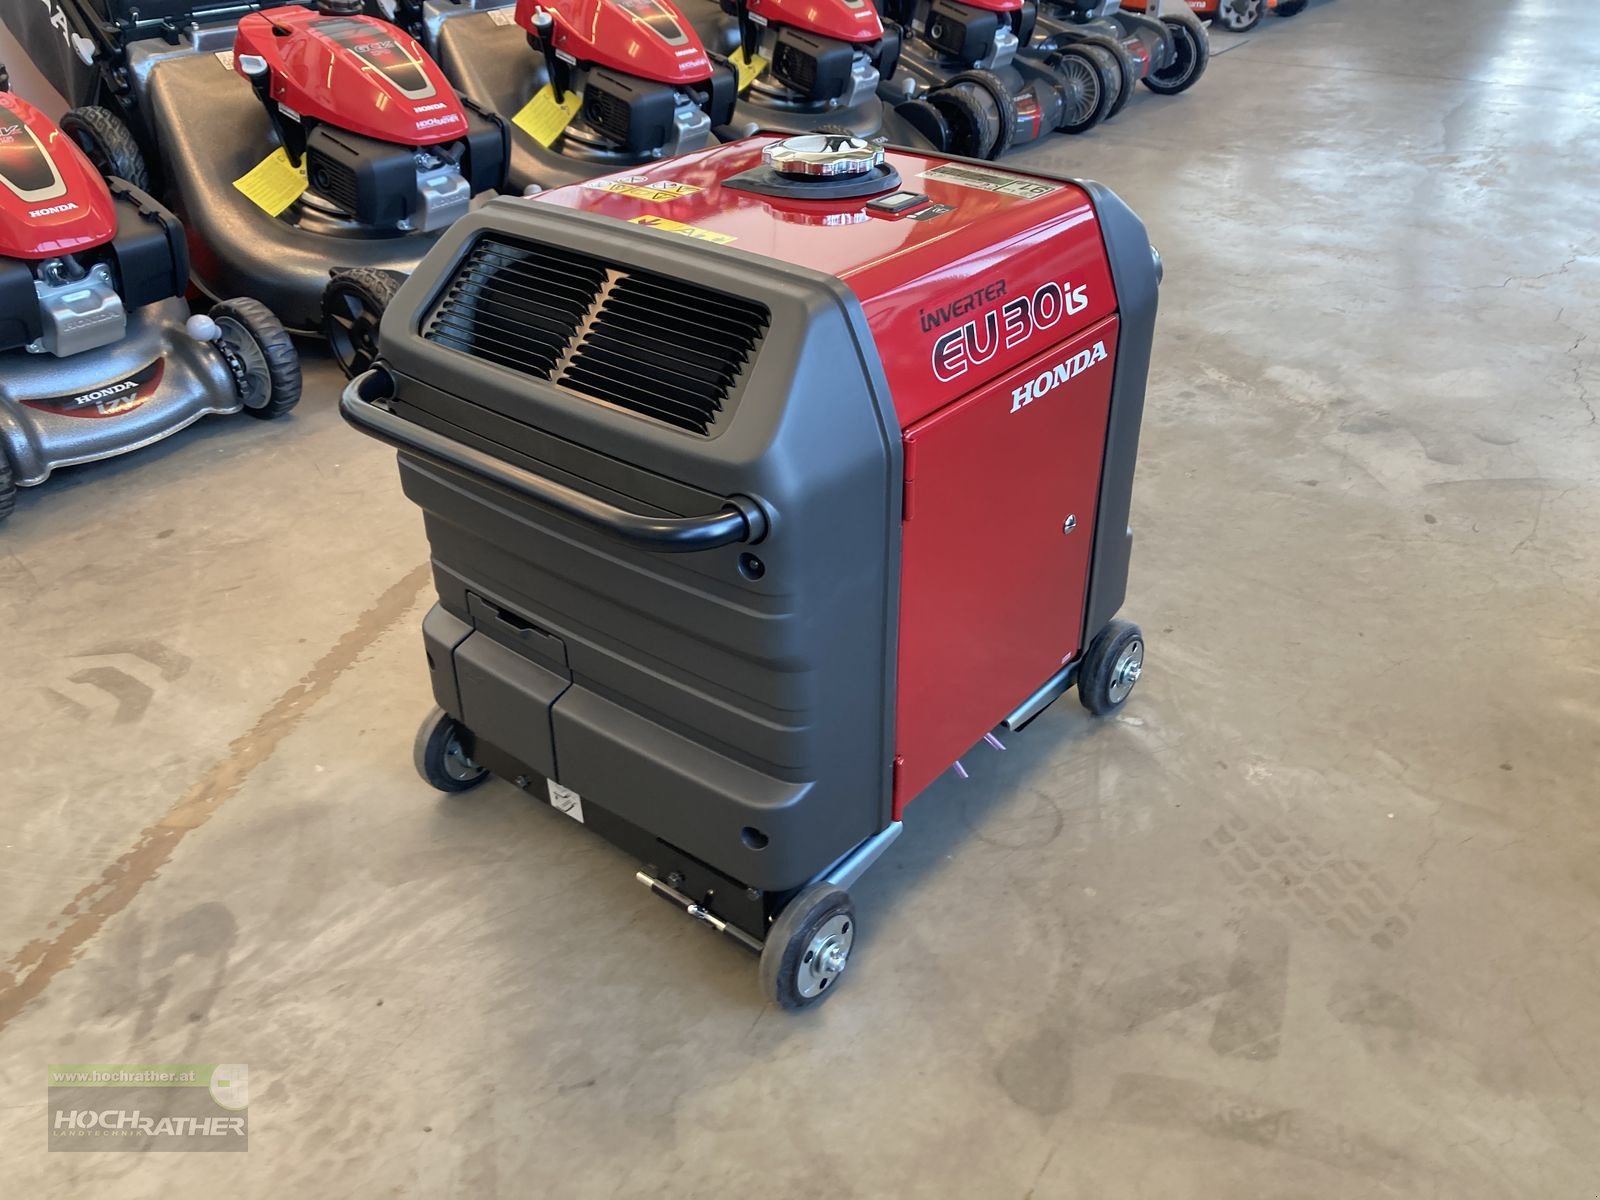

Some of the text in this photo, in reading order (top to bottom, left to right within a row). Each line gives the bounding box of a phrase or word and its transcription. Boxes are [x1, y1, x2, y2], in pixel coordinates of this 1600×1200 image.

[413, 102, 447, 113] HONDA
[28, 202, 79, 218] HONDA
[1009, 340, 1109, 414] HONDA
[74, 380, 140, 405] HONDA
